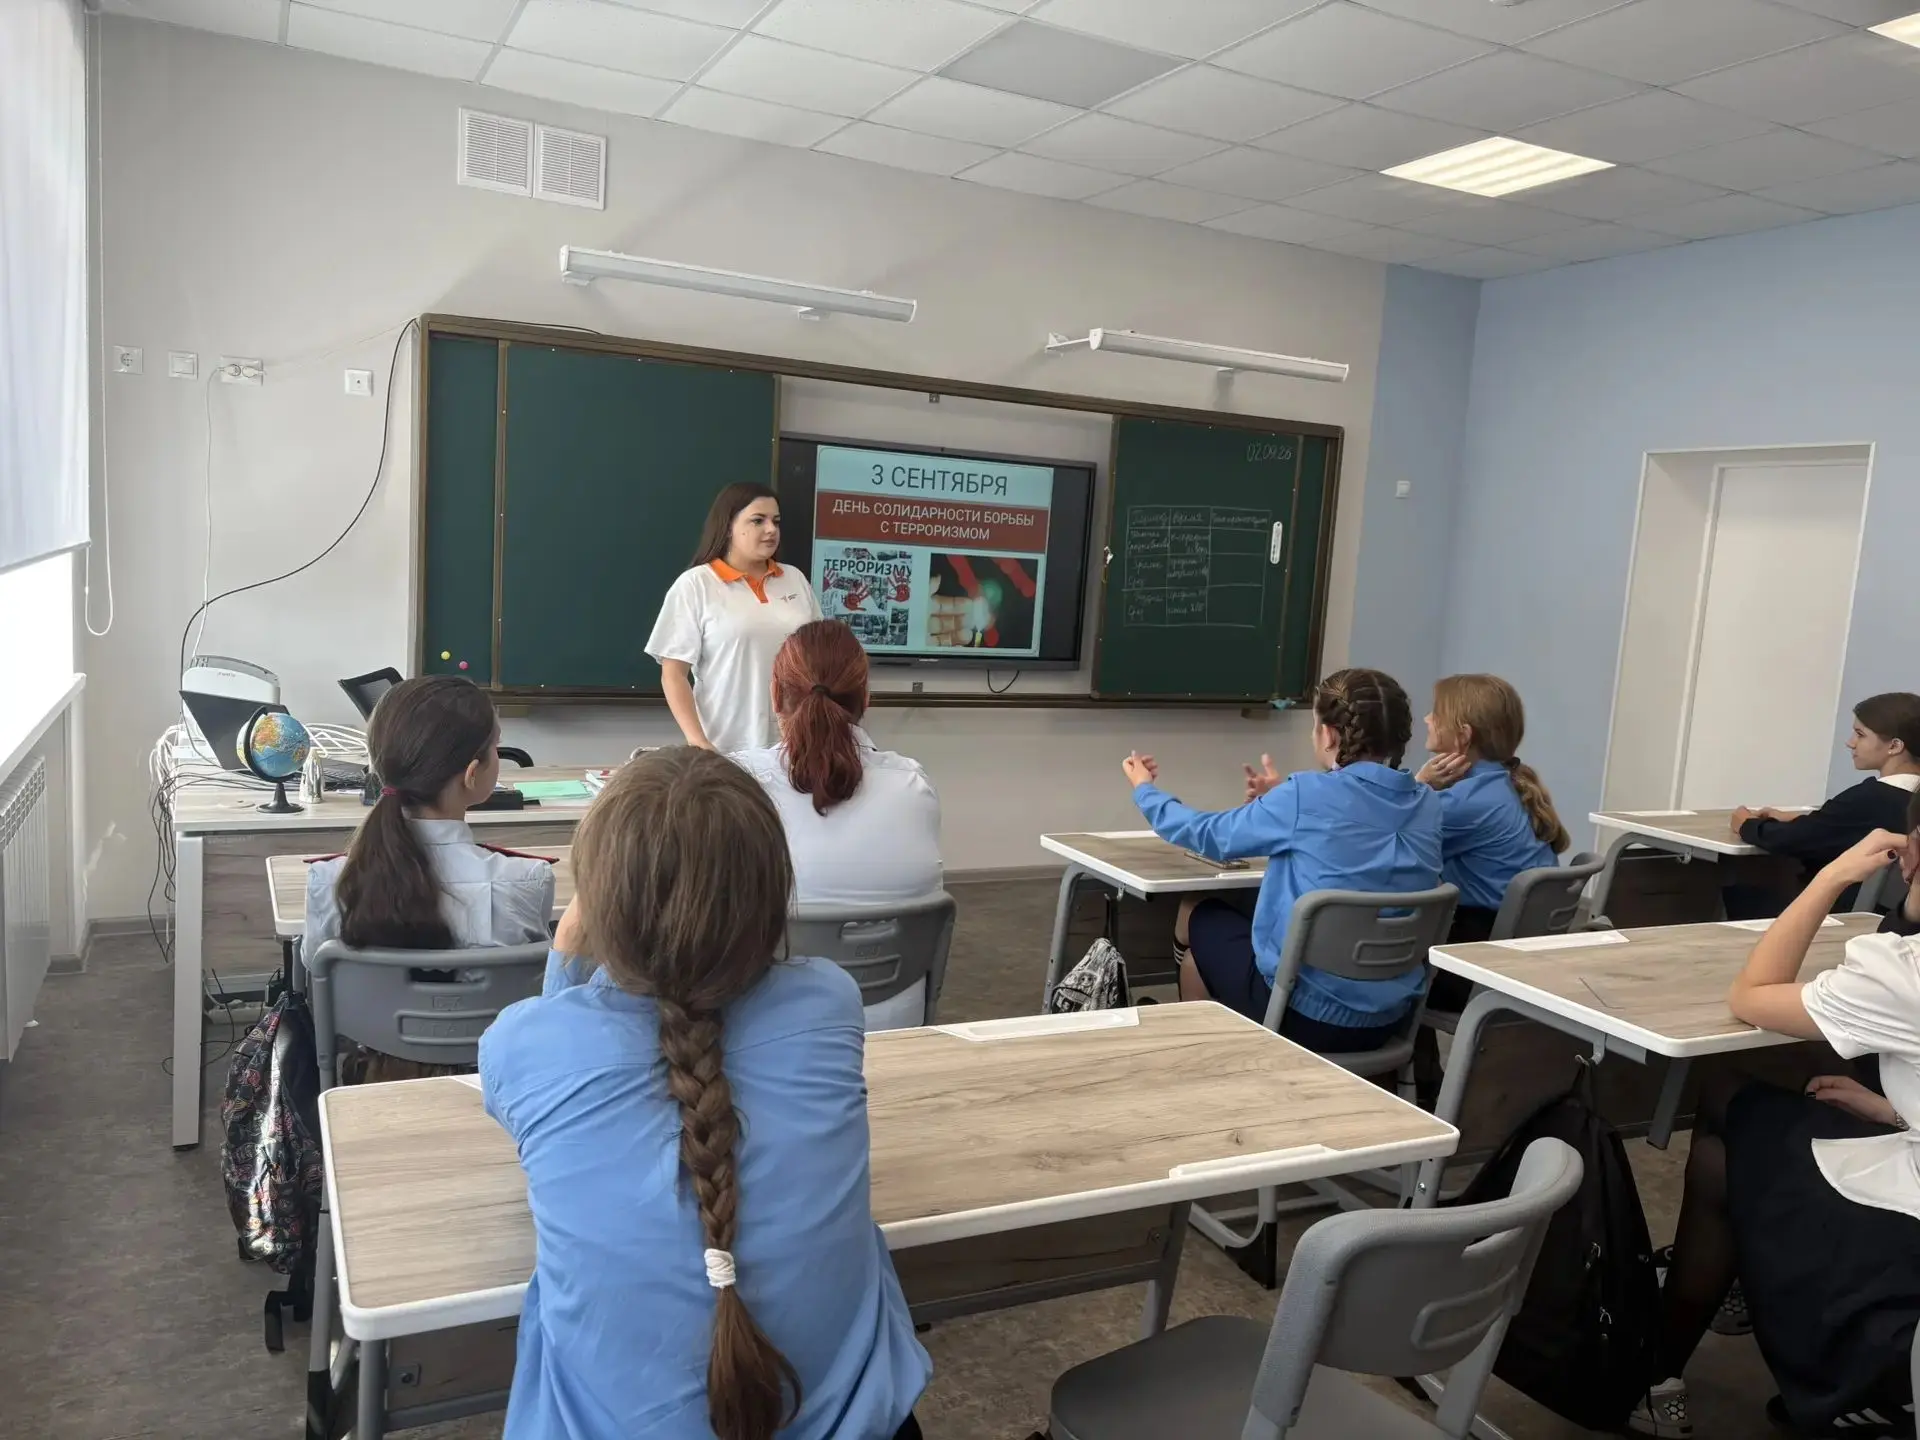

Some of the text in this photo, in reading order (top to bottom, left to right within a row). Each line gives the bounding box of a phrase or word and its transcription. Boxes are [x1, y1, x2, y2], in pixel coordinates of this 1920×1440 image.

[871, 464, 1008, 496] 3 СЕНТЯБРЯ
[832, 499, 1034, 527] ДЕНЬ СОЛИДАРНОСТИ БОРЬБЫ
[880, 521, 990, 541] С ТЕРРОРИЗМОМ
